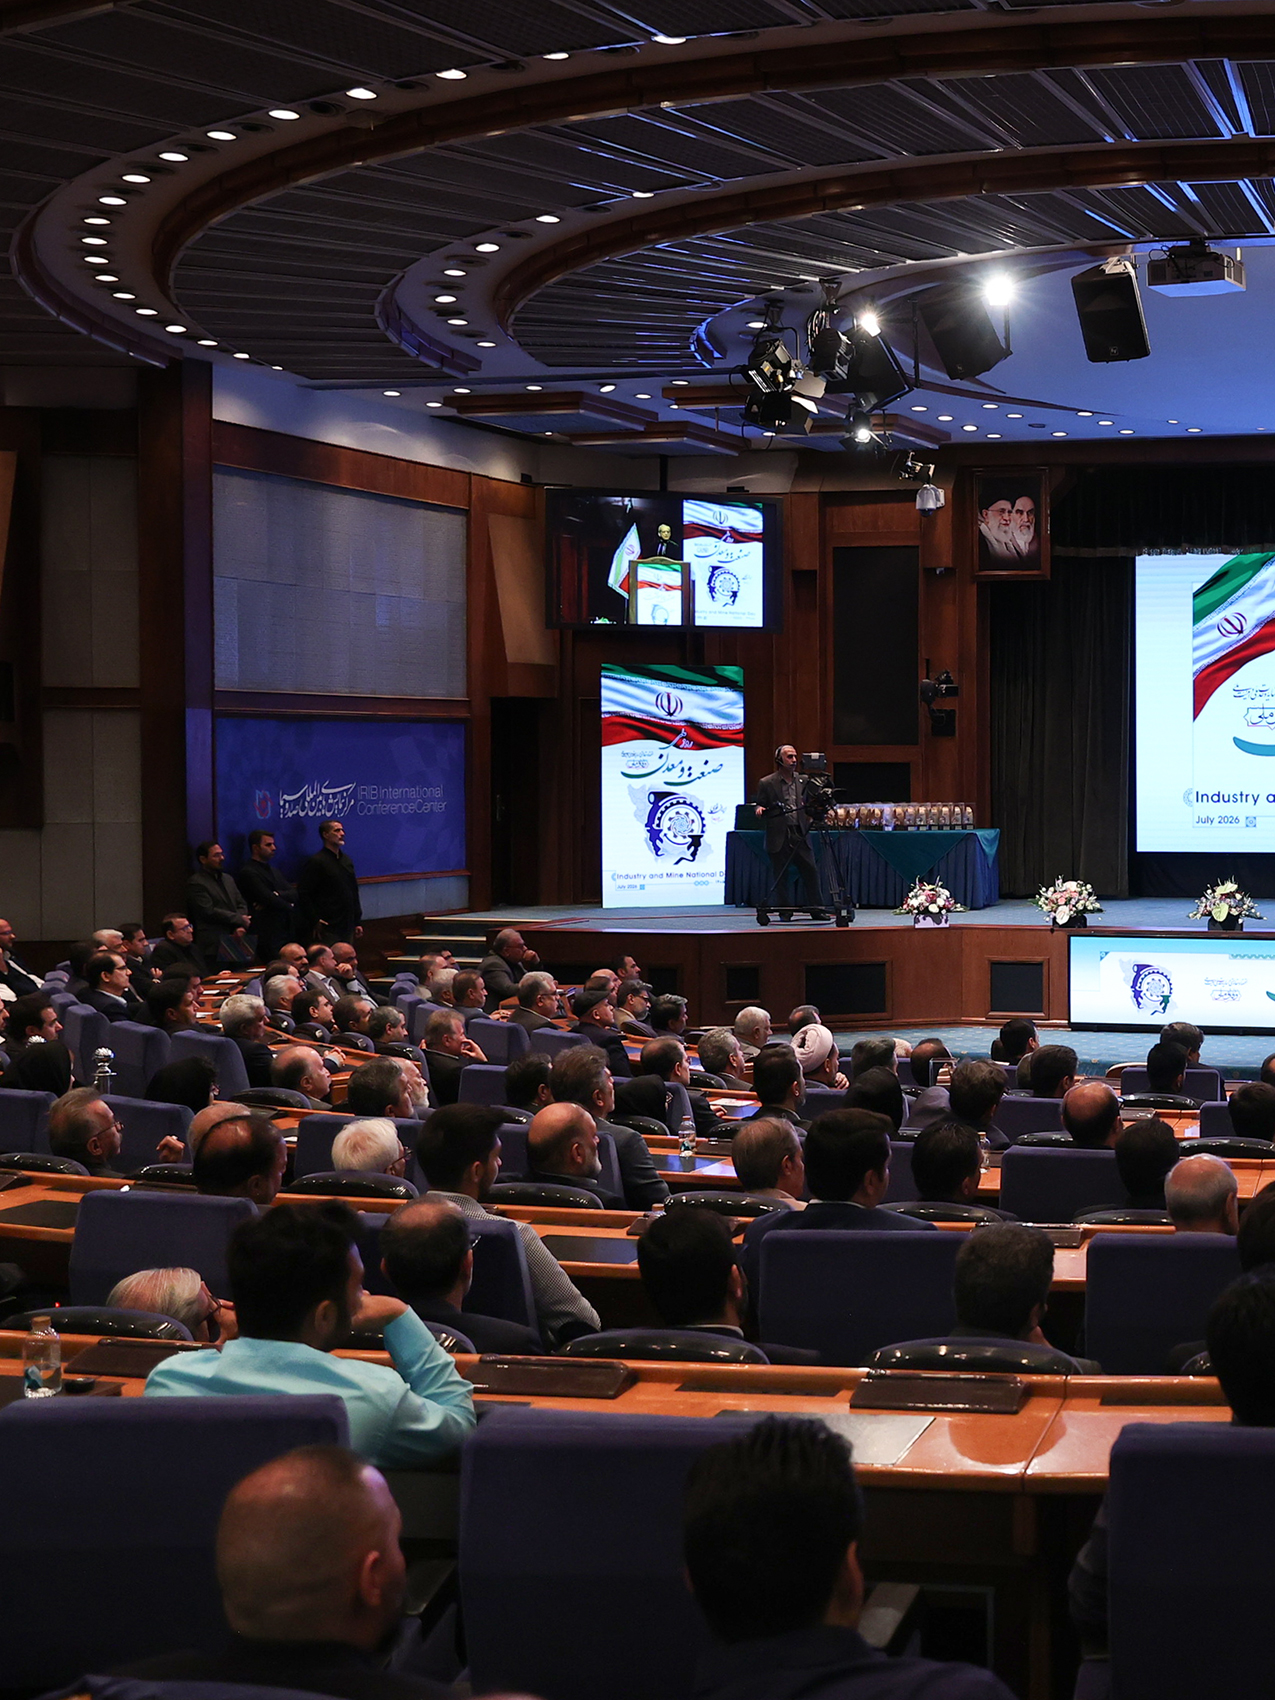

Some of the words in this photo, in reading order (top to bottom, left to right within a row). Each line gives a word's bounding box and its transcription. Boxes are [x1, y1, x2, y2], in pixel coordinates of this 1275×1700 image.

[620, 752, 683, 779] معدن
[663, 759, 723, 786] صنعت
[678, 766, 685, 778] و
[358, 785, 378, 800] IRIB
[380, 785, 443, 799] International
[1195, 790, 1260, 806] Industry
[1195, 815, 1215, 825] July
[1218, 815, 1240, 825] 2026
[616, 873, 646, 881] Industry
